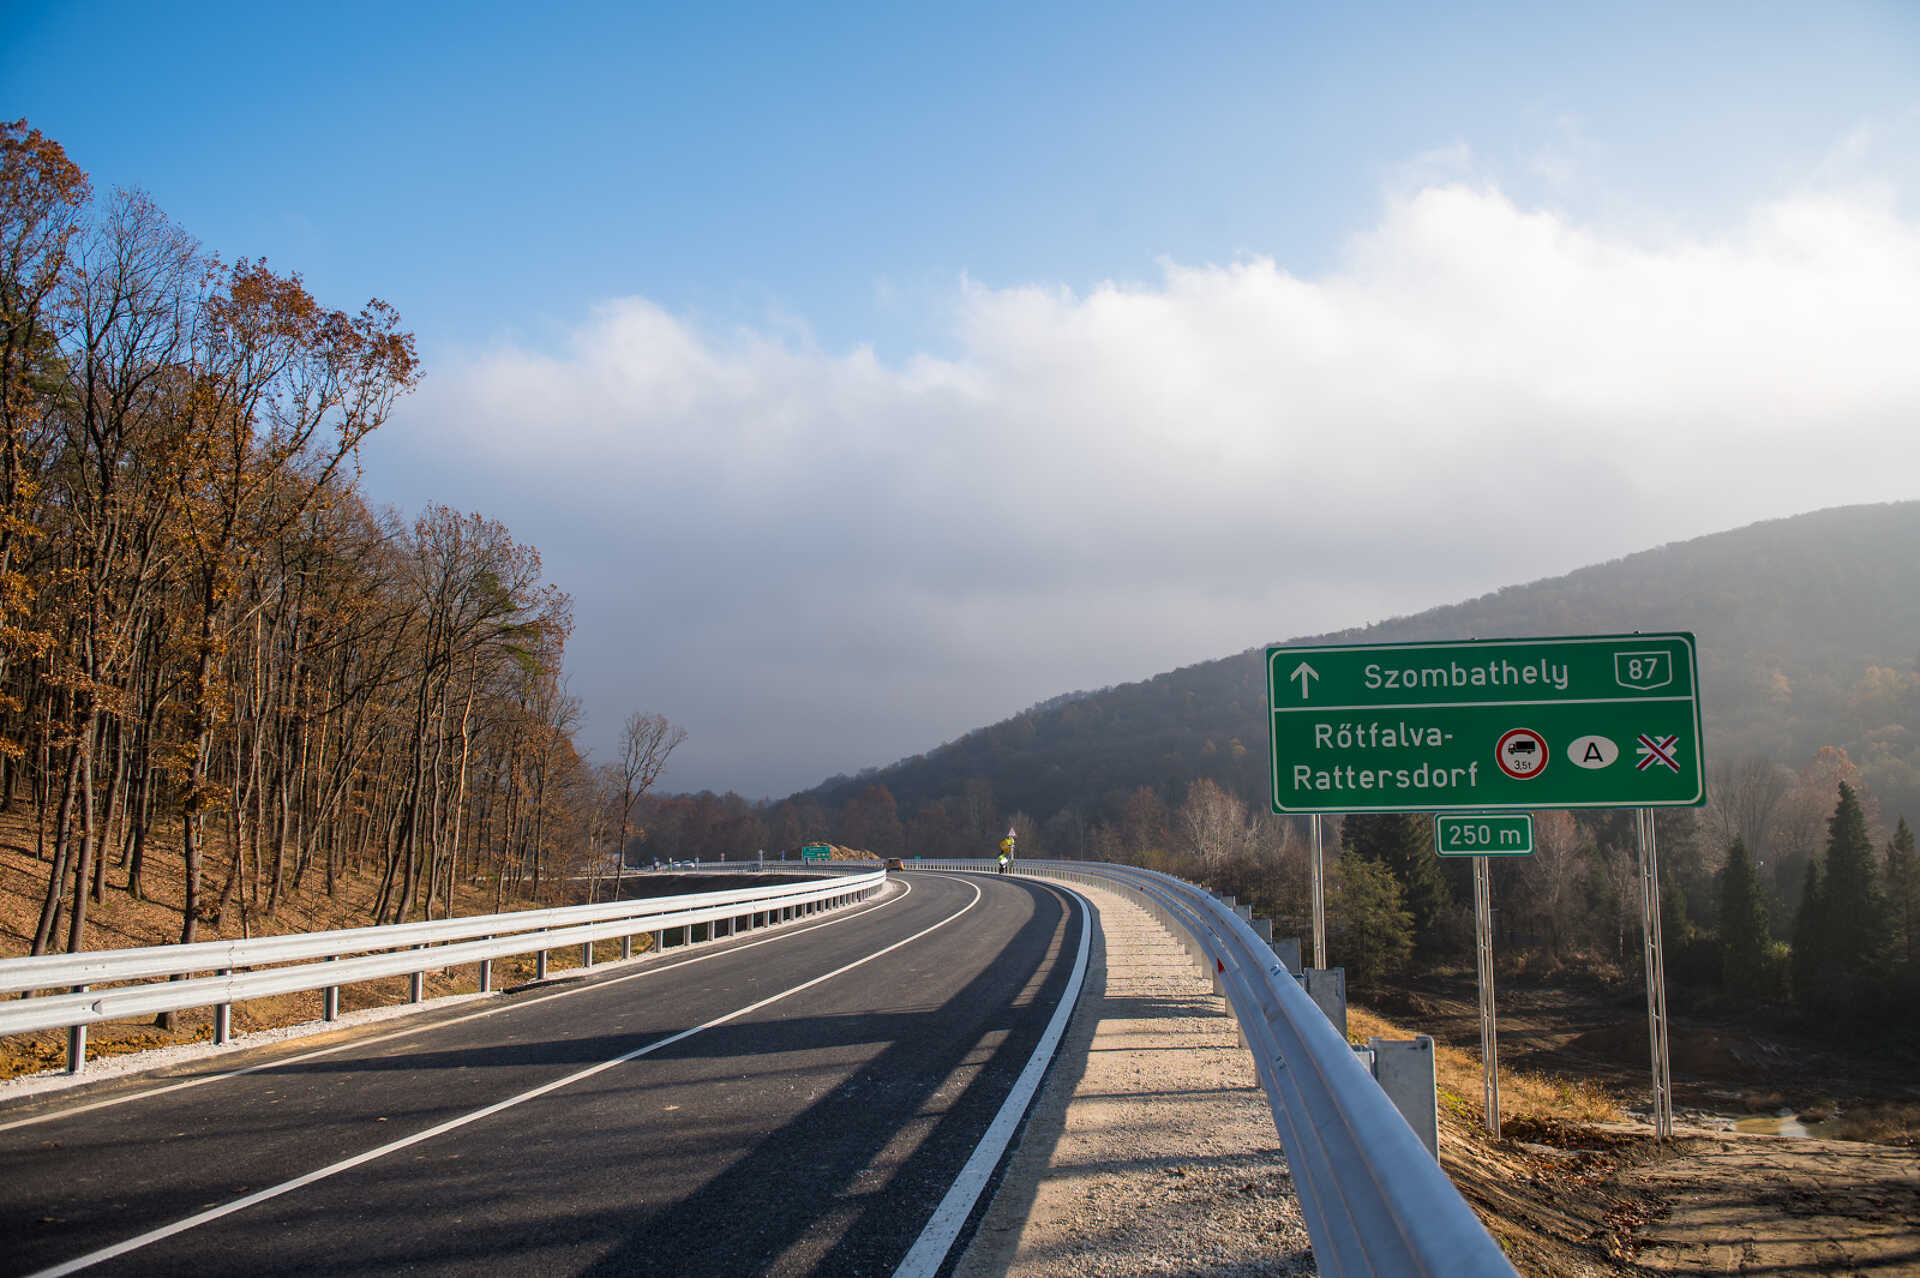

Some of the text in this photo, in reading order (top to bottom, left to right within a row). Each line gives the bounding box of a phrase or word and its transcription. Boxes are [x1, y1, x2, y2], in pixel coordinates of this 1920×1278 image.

[1364, 661, 1569, 690] Szombathely
[1628, 659, 1658, 680] 87
[1314, 723, 1454, 749] Rőtfalva-
[1583, 742, 1604, 763] A
[1293, 763, 1479, 791] Rattersdorf
[1449, 825, 1521, 845] 250 m
